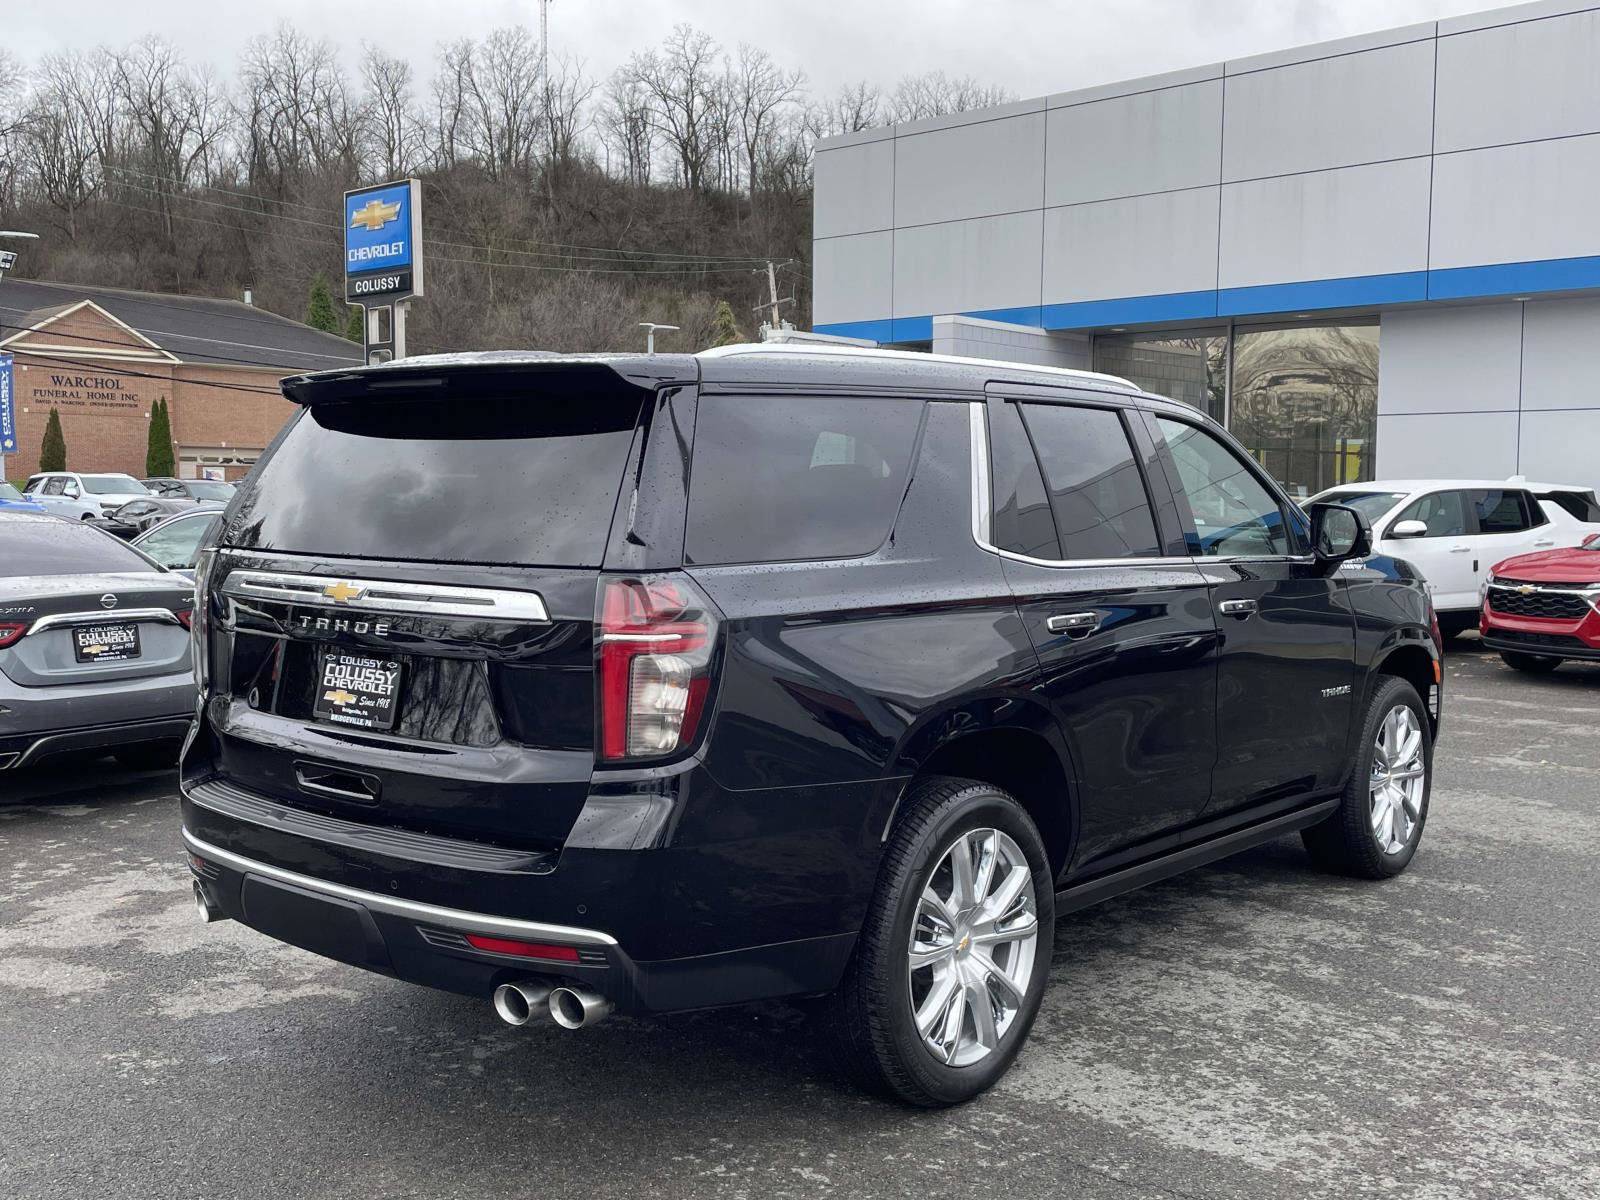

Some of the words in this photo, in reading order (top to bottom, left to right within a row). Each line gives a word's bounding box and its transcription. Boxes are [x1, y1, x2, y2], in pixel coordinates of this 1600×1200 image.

[348, 241, 404, 262] CHEVROLET
[355, 275, 400, 293] COLUSSY
[51, 375, 125, 390] WARCHOL
[33, 388, 82, 399] FUNERAL
[86, 391, 117, 401] HOME
[121, 393, 141, 402] INC.
[299, 615, 389, 636] TAHOE
[79, 629, 135, 641] COLUSSY
[80, 636, 135, 646] CHEVROLET
[340, 656, 383, 668] COLUSSY
[325, 663, 398, 686] COLUSSY
[323, 676, 394, 695] CHEVROLET
[1321, 684, 1351, 698] TAHOE
[359, 695, 376, 707] Since
[375, 697, 391, 709] 1918
[364, 718, 372, 728] PA
